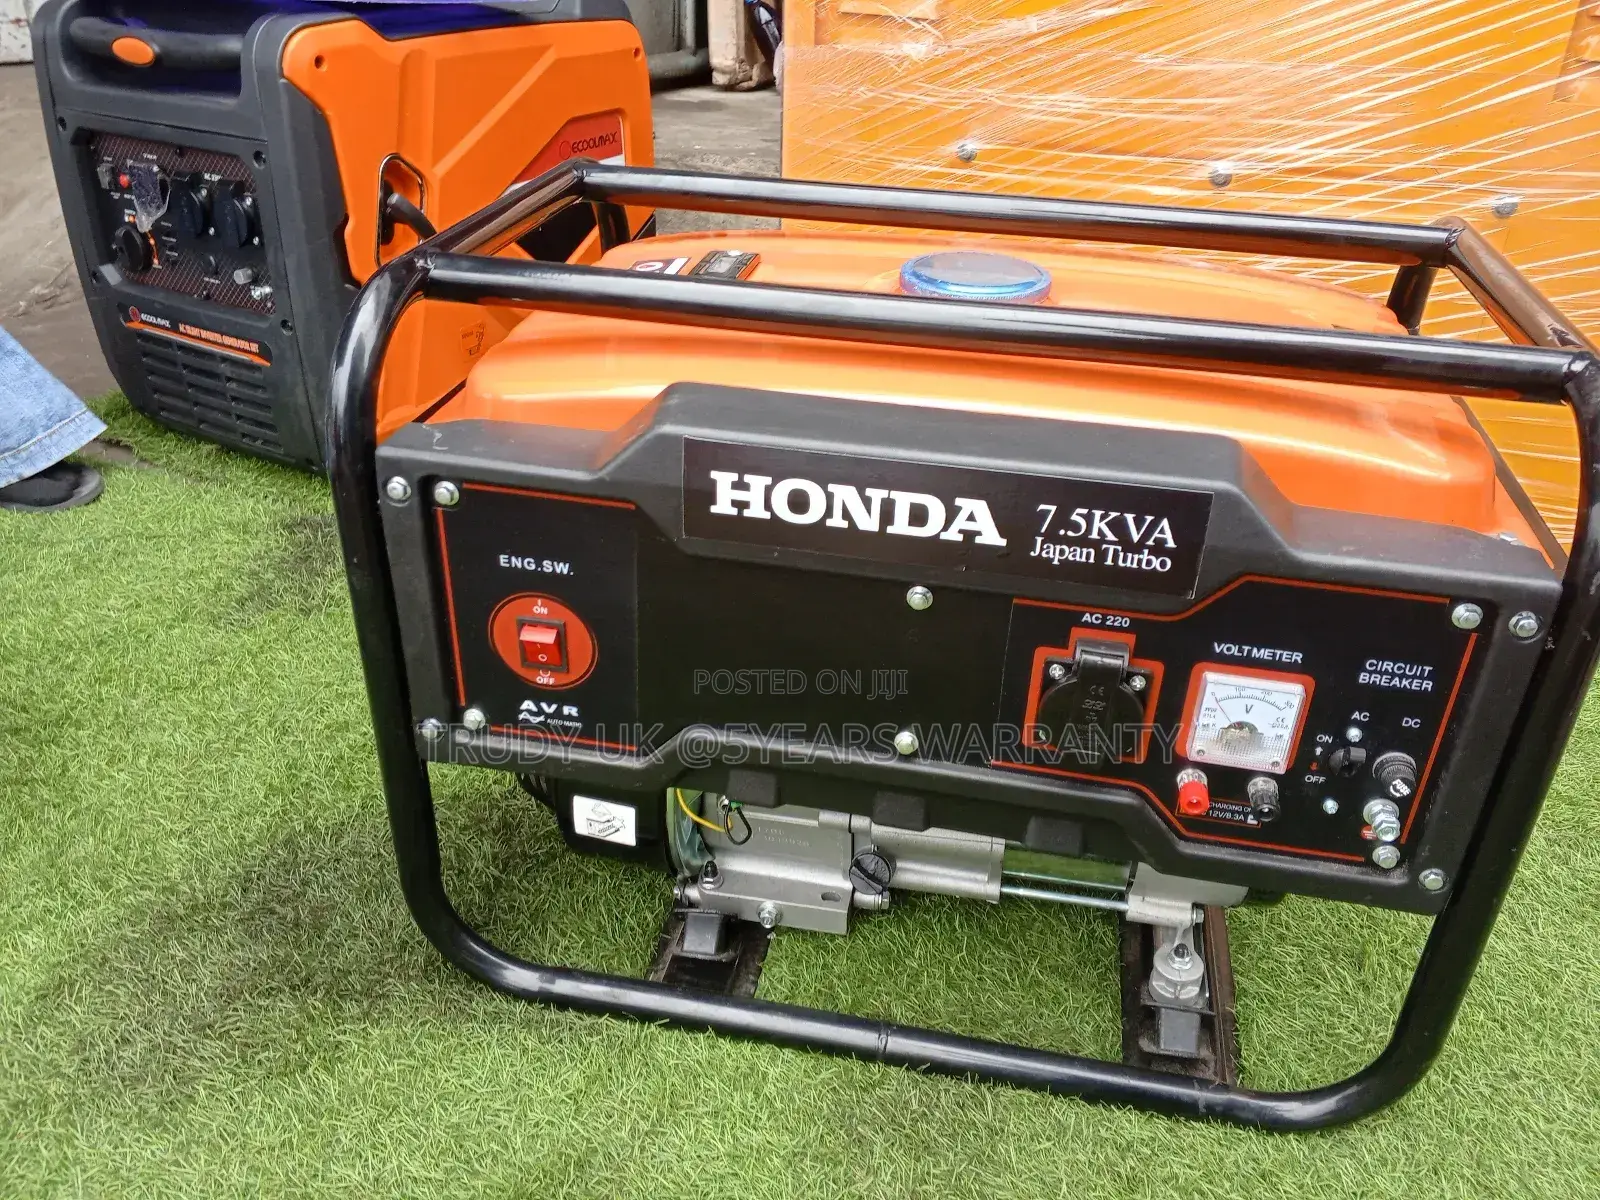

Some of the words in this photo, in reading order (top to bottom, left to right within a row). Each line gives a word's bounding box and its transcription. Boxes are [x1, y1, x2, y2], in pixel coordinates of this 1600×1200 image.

[571, 131, 618, 153] ECOOLMAX
[709, 470, 1008, 547] HONDA
[1030, 535, 1095, 565] Japan
[1101, 544, 1173, 573] Turbo
[499, 554, 574, 576] ENG.SW.
[533, 605, 548, 615] ON
[1081, 612, 1102, 625] AC
[1105, 614, 1130, 628] 220
[1365, 659, 1433, 678] CIRCUIT
[536, 676, 555, 685] OFF
[1358, 672, 1433, 693] BREAKER
[520, 700, 579, 716] AVR
[1245, 703, 1254, 715] V
[1351, 711, 1370, 722] AC
[1402, 717, 1421, 728] DC
[1317, 733, 1333, 744] ON
[1305, 774, 1327, 785] OFF
[1392, 779, 1411, 796] FUSE
[1209, 811, 1245, 821] 12V/8.3A
